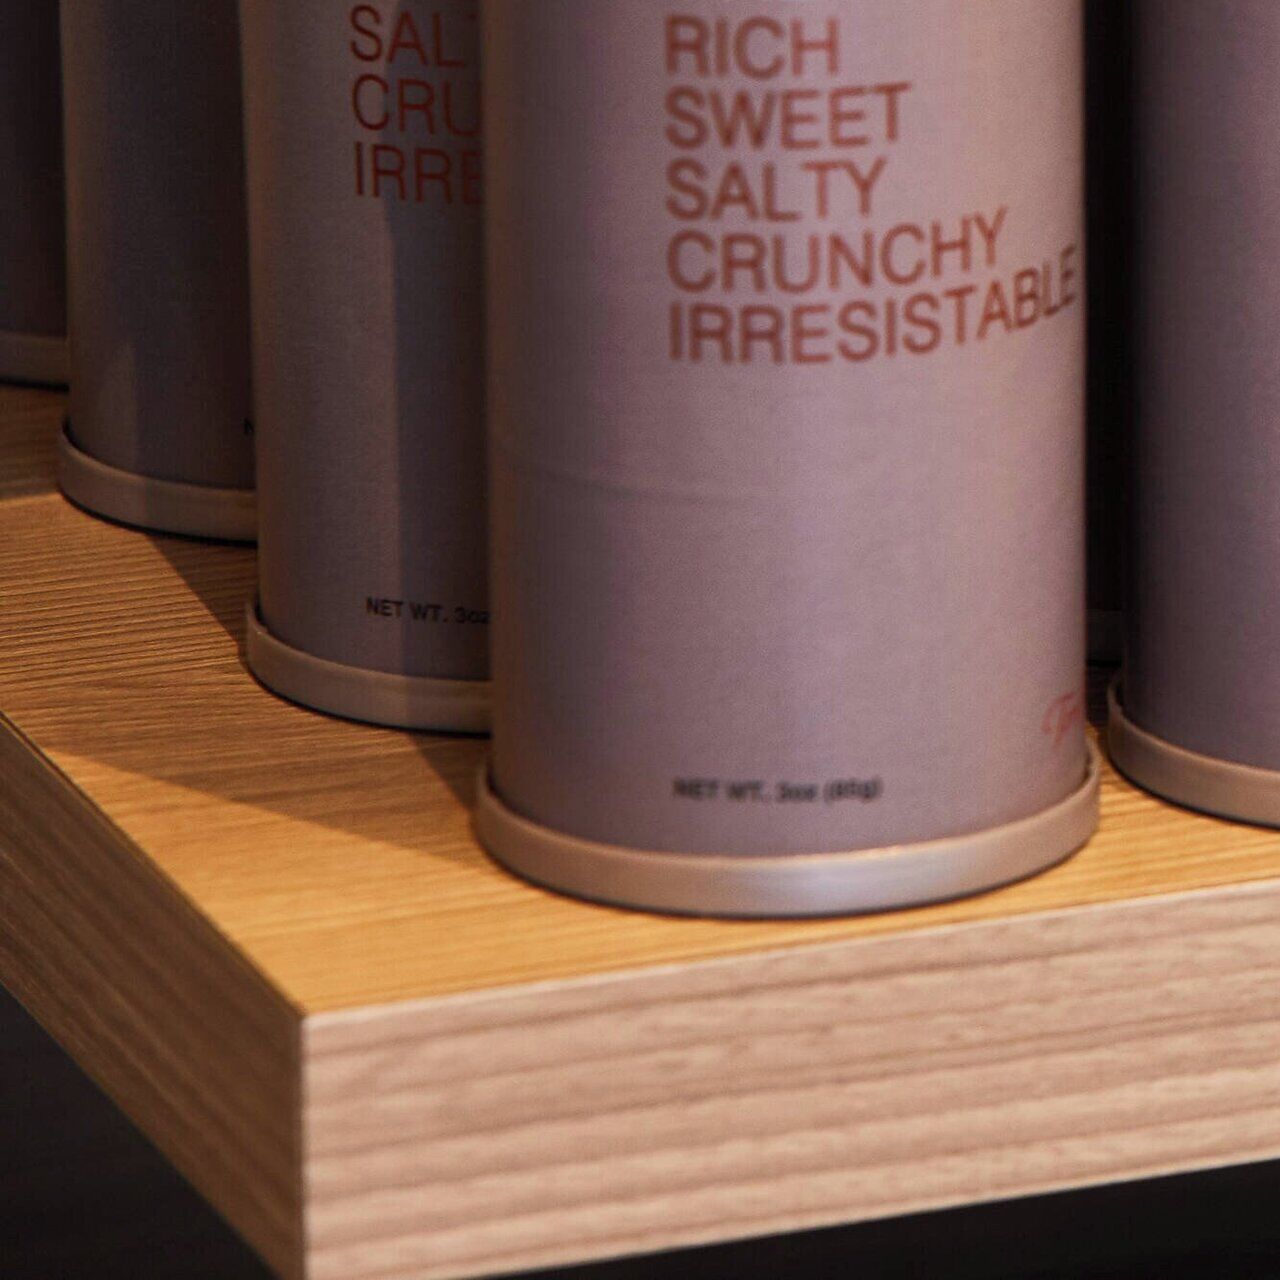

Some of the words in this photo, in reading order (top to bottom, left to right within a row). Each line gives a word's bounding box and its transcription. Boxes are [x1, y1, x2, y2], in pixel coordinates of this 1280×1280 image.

[664, 16, 839, 80] RICH
[664, 82, 911, 150] SWEET
[665, 156, 887, 221] SALTY
[666, 206, 1007, 294] CRUNCHY
[668, 243, 1077, 365] IRRESISTABLE
[365, 596, 403, 617] NET
